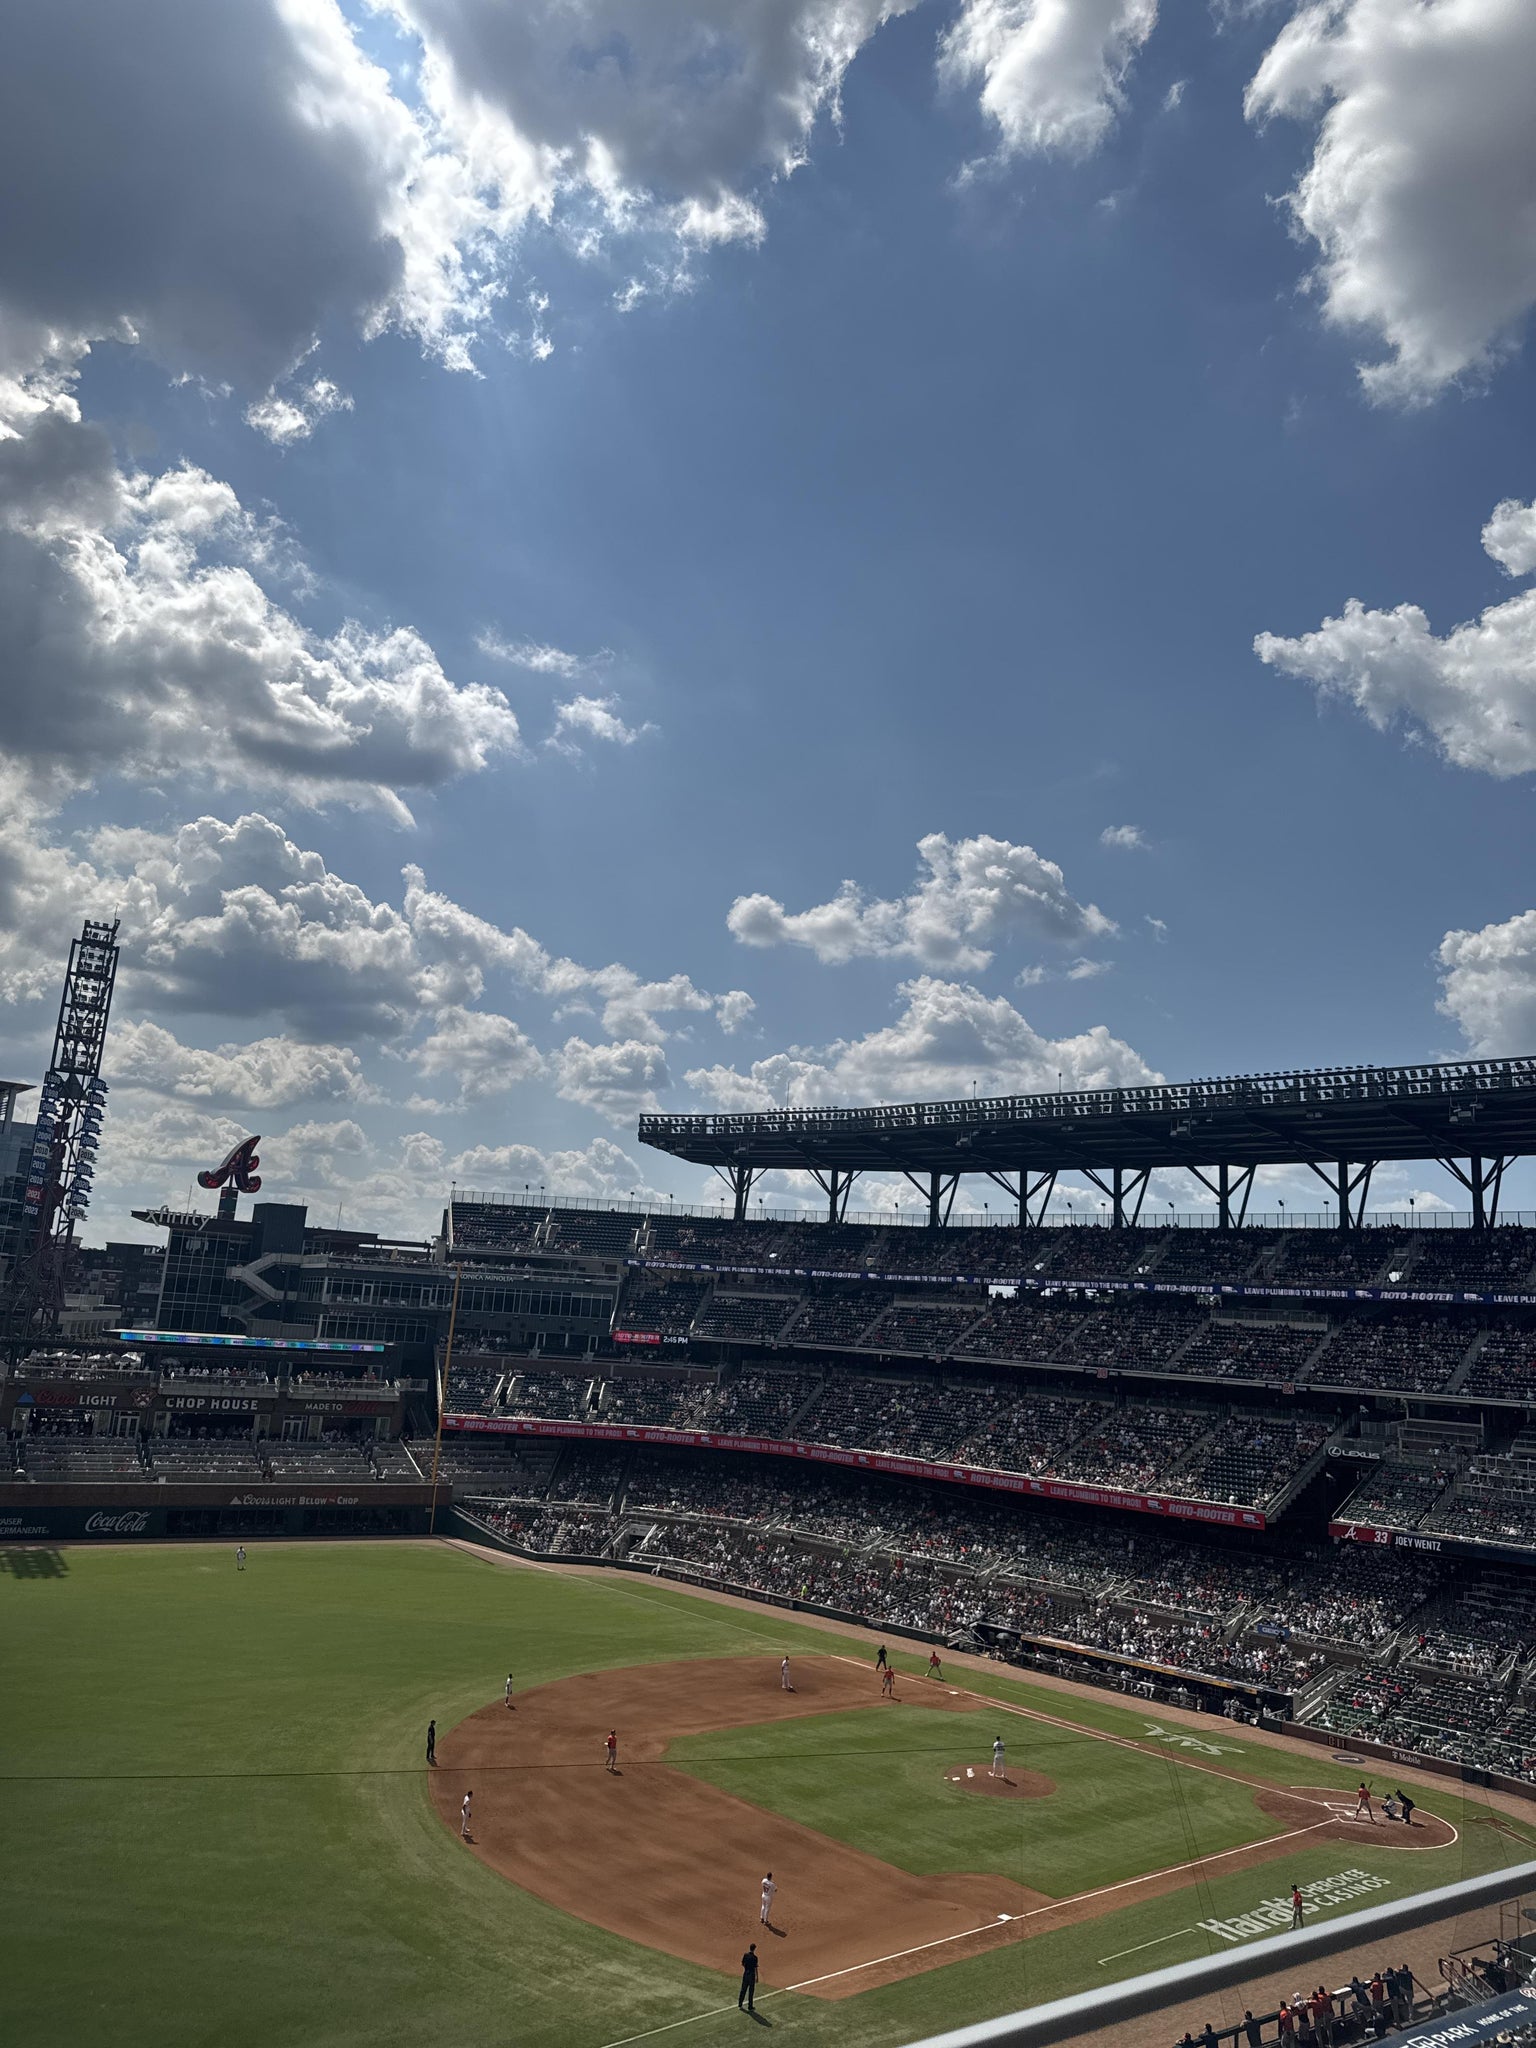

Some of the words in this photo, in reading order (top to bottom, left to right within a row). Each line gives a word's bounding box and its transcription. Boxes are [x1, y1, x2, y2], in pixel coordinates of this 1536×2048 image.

[35, 1146, 49, 1155] 2010
[33, 1160, 46, 1170] 2013
[76, 1180, 89, 1189] 2020
[27, 1190, 41, 1199] 2021
[73, 1194, 86, 1203] 2022
[25, 1206, 38, 1215] 2023
[145, 1204, 211, 1231] xfinity
[1154, 1284, 1213, 1293] ROTO-ROOTER
[1380, 1292, 1454, 1300] ROTO-ROOTER
[80, 1396, 117, 1406] LIGHT
[166, 1398, 205, 1408] CHOP
[210, 1399, 258, 1410] HOUSE
[464, 1421, 518, 1431] ROTO-ROOTER
[645, 1432, 694, 1443] ROTO-ROOTER
[810, 1450, 854, 1463] ROTO-ROOTER
[1342, 1450, 1380, 1460] LEXUS
[970, 1474, 1024, 1489] ROTO-ROOTER
[243, 1494, 270, 1504] Coors
[299, 1496, 327, 1505] BELOW
[337, 1496, 359, 1504] CHOP
[1169, 1504, 1235, 1523] ROTO-ROOTER
[85, 1512, 151, 1532] Coca-Cola
[0, 1526, 47, 1534] ERMANENTE
[1374, 1531, 1388, 1543] 33
[1394, 1536, 1413, 1547] JOEY
[1414, 1539, 1441, 1551] WENTZ
[1399, 1753, 1420, 1764] Mobile
[1298, 1868, 1371, 1898] CHEROKEE
[1316, 1876, 1391, 1907] CASINOS
[1476, 2014, 1504, 2026] HOME
[1499, 2010, 1512, 2018] OF
[1431, 2023, 1480, 2046] PARK
